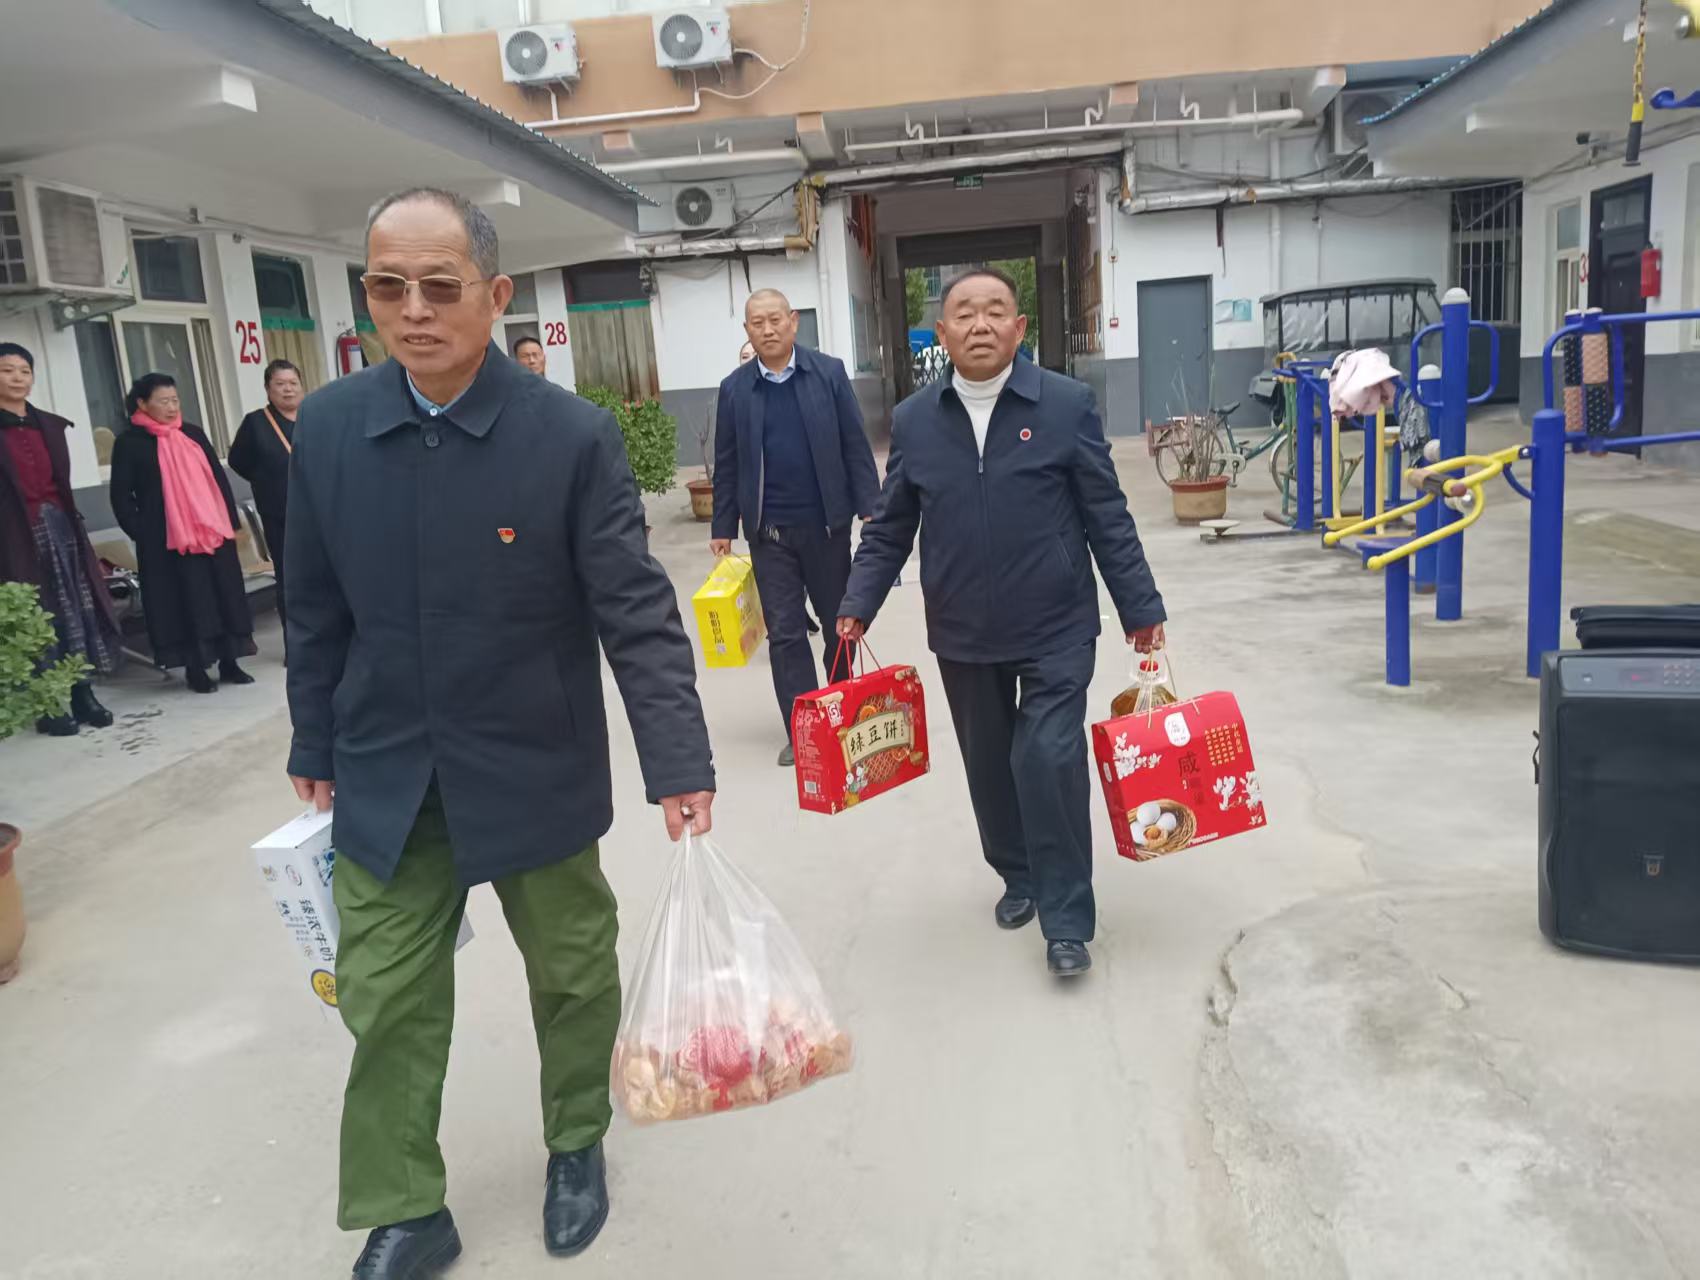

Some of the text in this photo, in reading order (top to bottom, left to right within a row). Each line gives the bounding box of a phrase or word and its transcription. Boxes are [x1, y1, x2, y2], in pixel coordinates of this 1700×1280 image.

[235, 320, 261, 364] 25
[545, 321, 567, 346] 28
[850, 719, 898, 755] 绿豆饼
[299, 898, 336, 962] 臻浓牛奶
